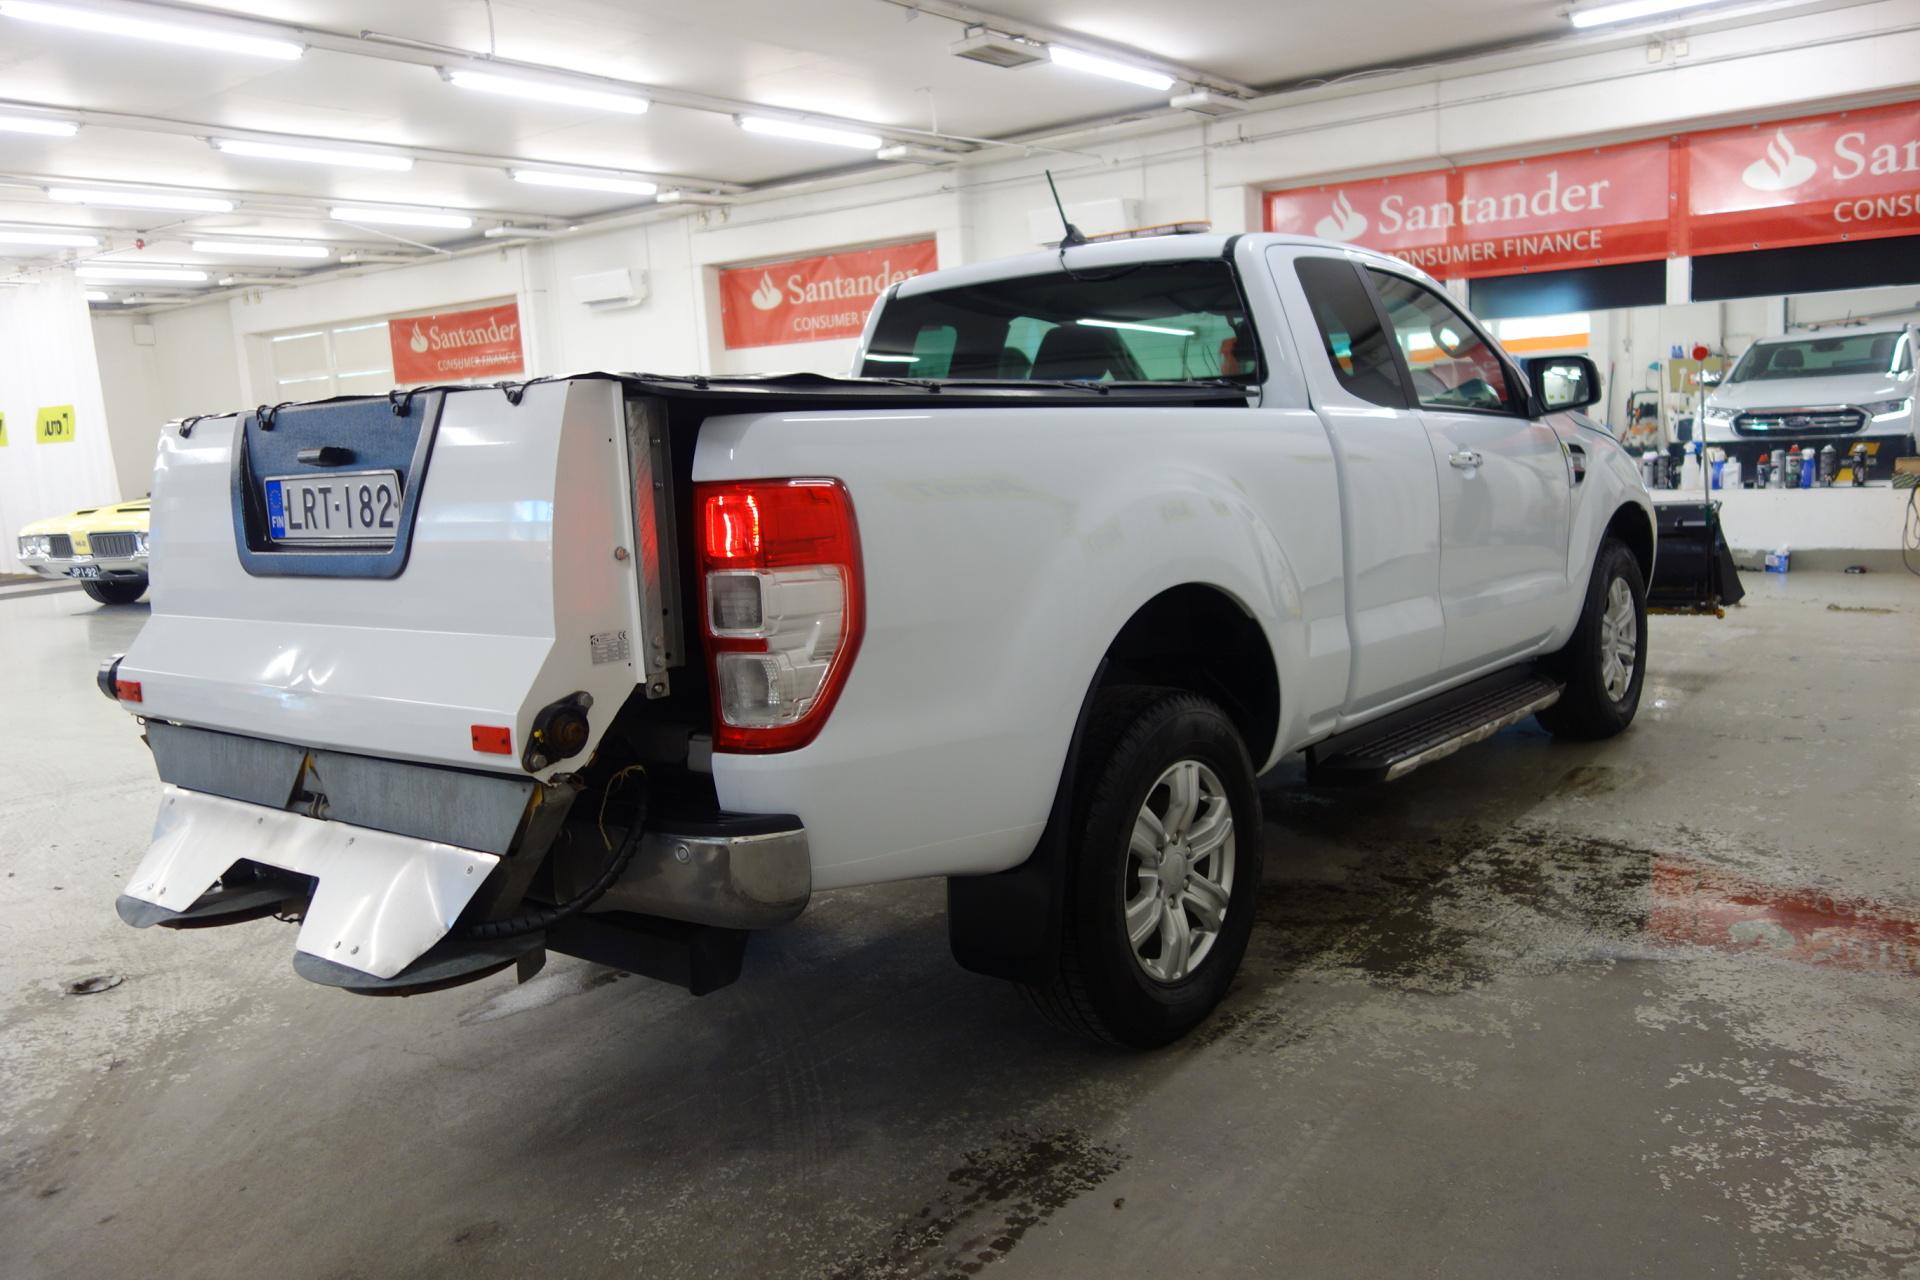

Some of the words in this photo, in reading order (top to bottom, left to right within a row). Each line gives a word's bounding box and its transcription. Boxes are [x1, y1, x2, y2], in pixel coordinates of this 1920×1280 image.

[1378, 170, 1609, 235] Santander
[1385, 243, 1496, 267] ONSUMER
[1504, 229, 1602, 257] FINANCE
[429, 316, 517, 351] Santander
[793, 311, 859, 332] CONSUMER
[438, 356, 480, 372] CONSUMER
[482, 352, 518, 367] FINANCE
[271, 516, 284, 528] FIN
[286, 483, 394, 531] LRT-182
